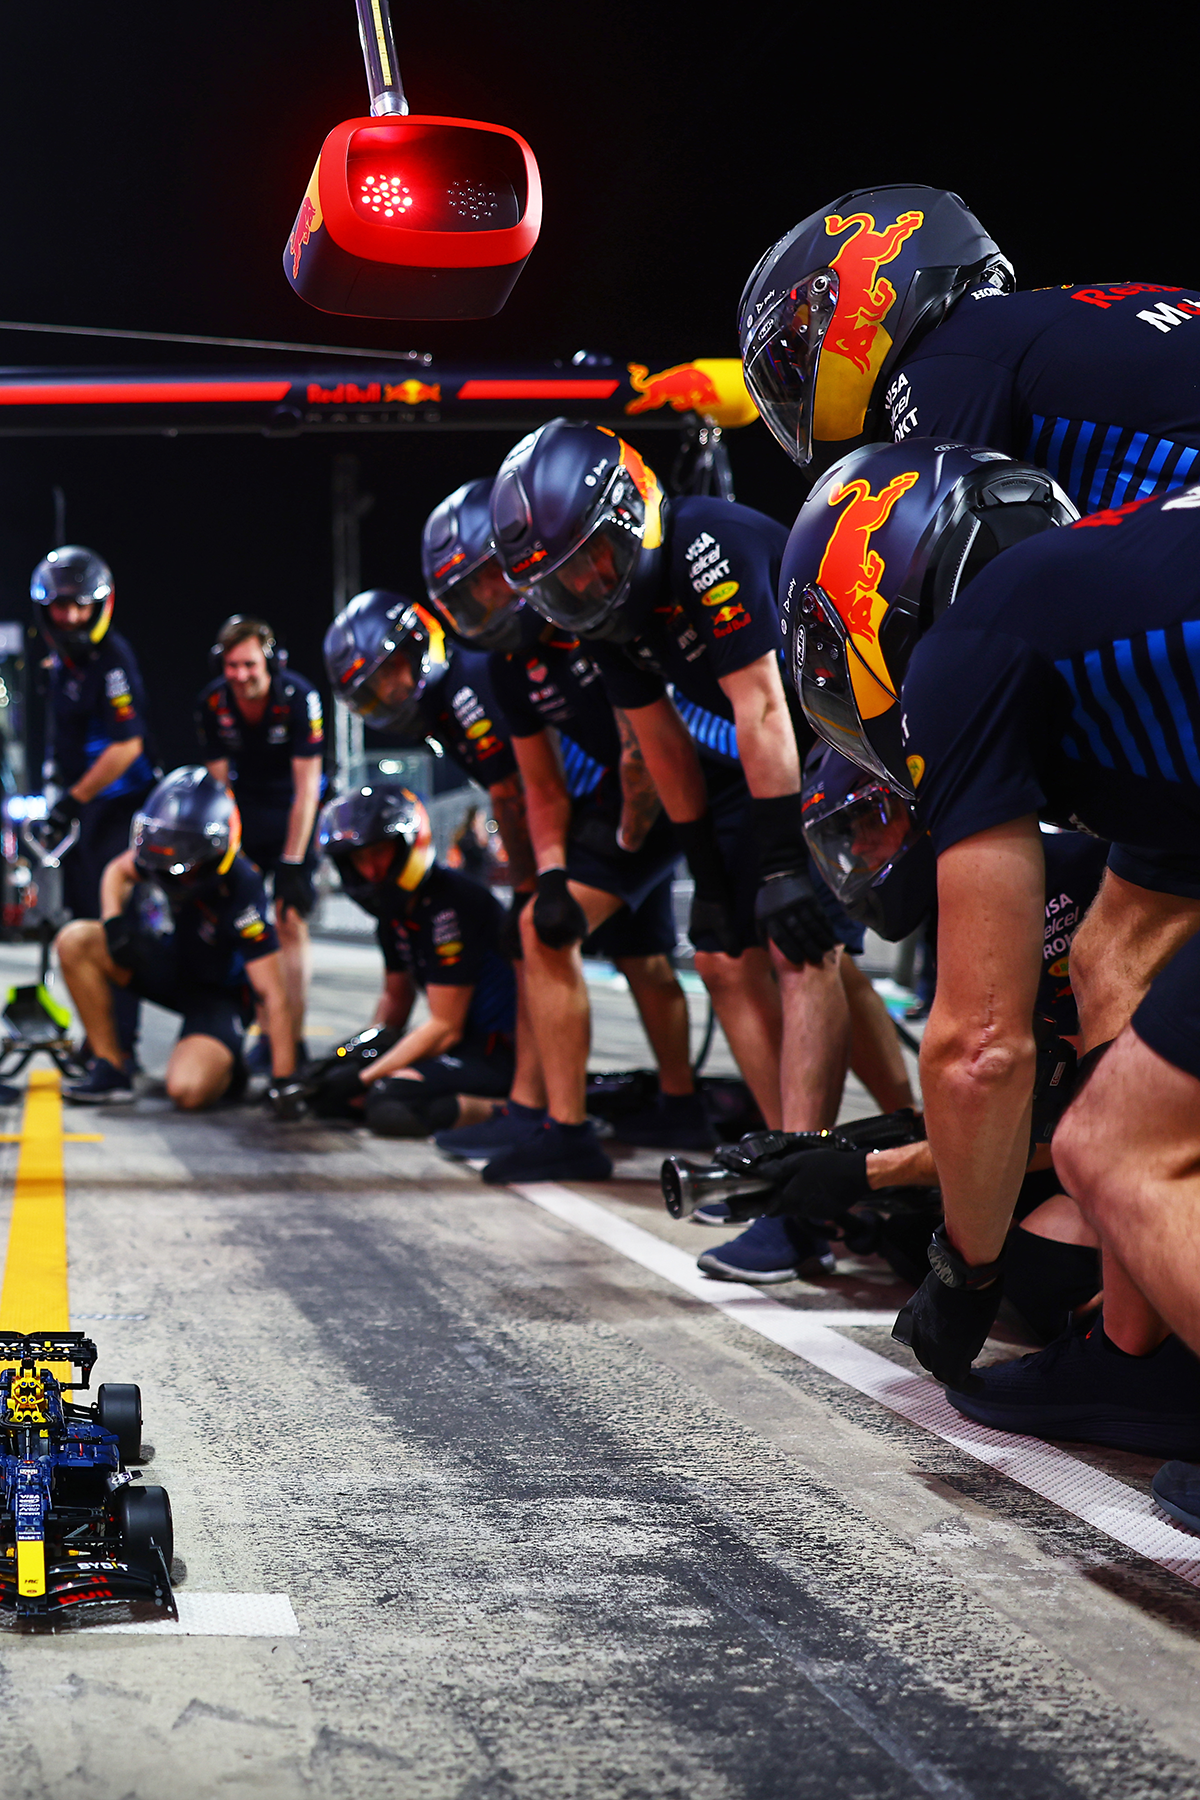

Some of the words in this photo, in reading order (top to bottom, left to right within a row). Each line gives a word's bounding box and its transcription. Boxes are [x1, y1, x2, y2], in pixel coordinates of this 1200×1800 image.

[895, 407, 918, 443] OKT
[692, 559, 729, 593] ROKT
[1045, 893, 1073, 918] ISA
[1044, 906, 1079, 939] elcel
